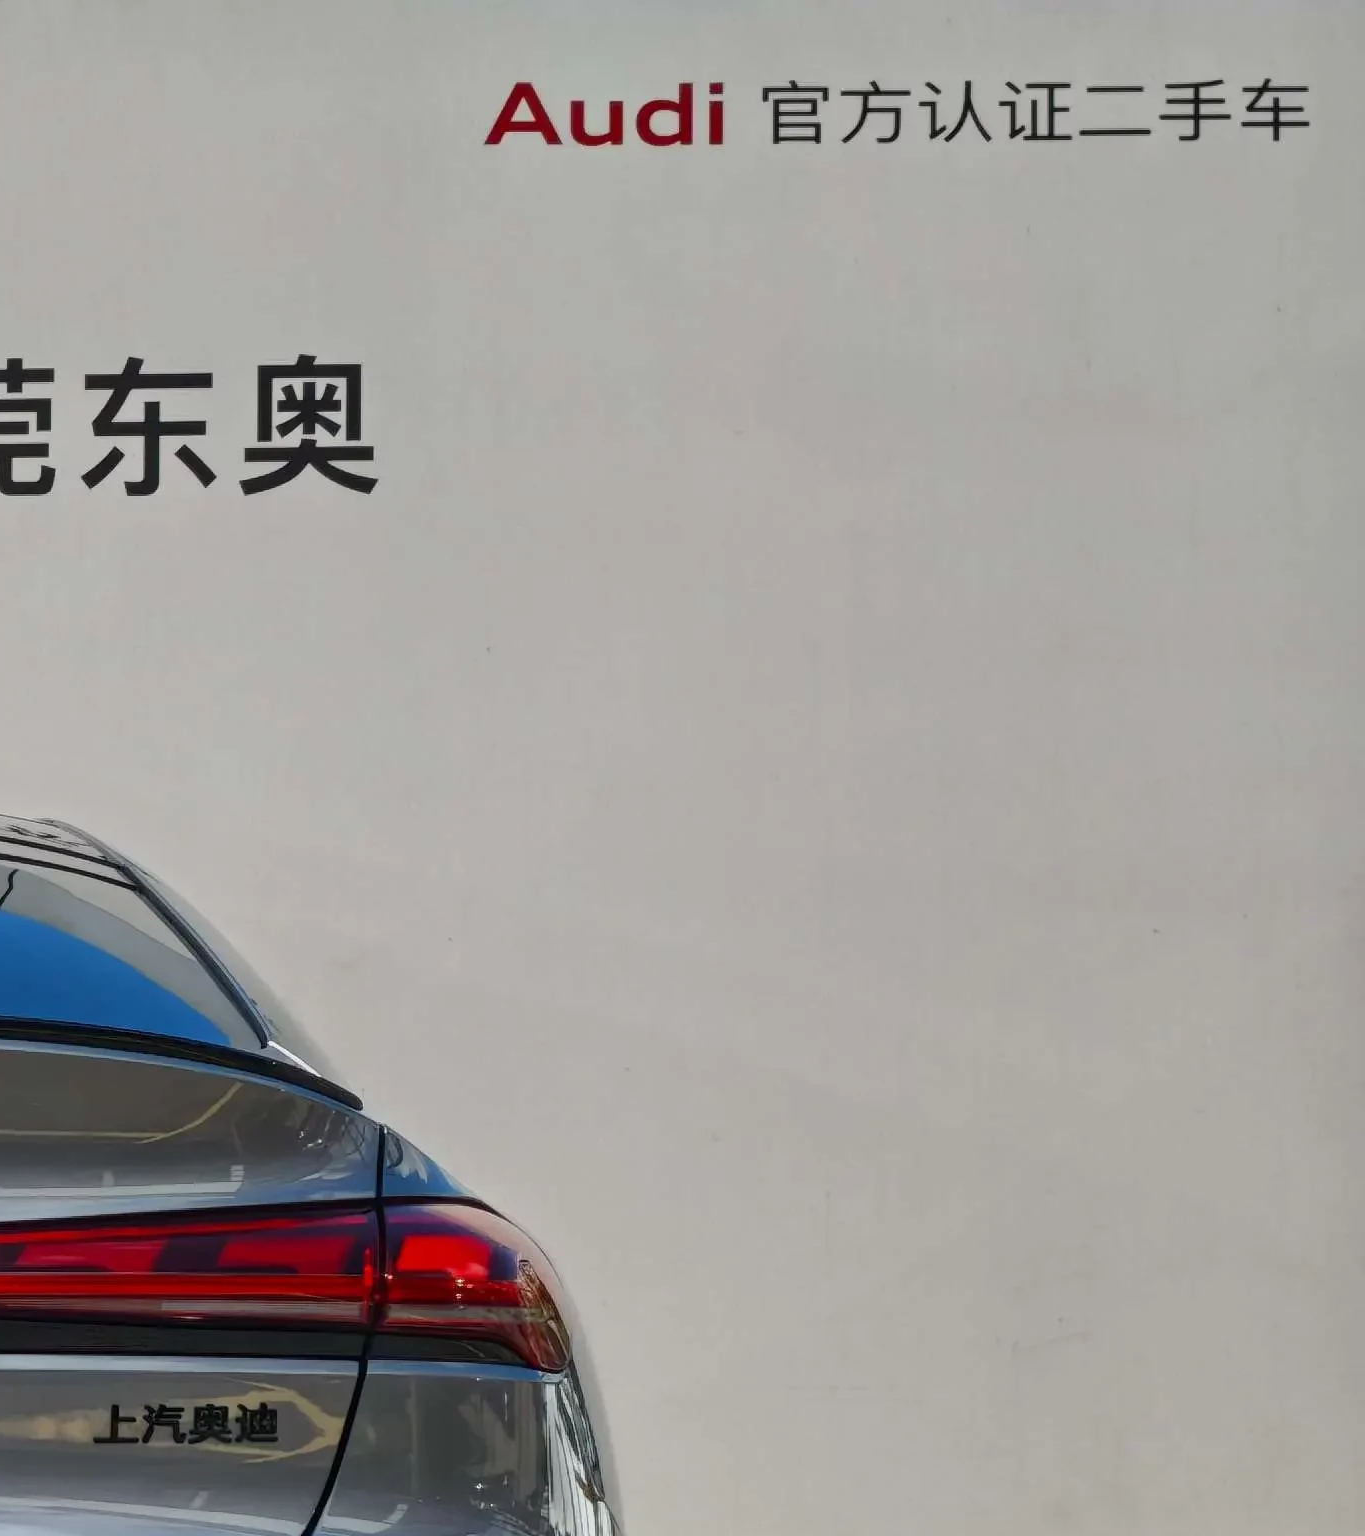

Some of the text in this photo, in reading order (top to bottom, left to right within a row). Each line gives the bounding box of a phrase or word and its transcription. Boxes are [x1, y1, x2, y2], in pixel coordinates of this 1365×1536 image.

[483, 78, 1311, 147] Audi 官方认证二手车
[93, 1403, 279, 1445] 上汽奥迪
